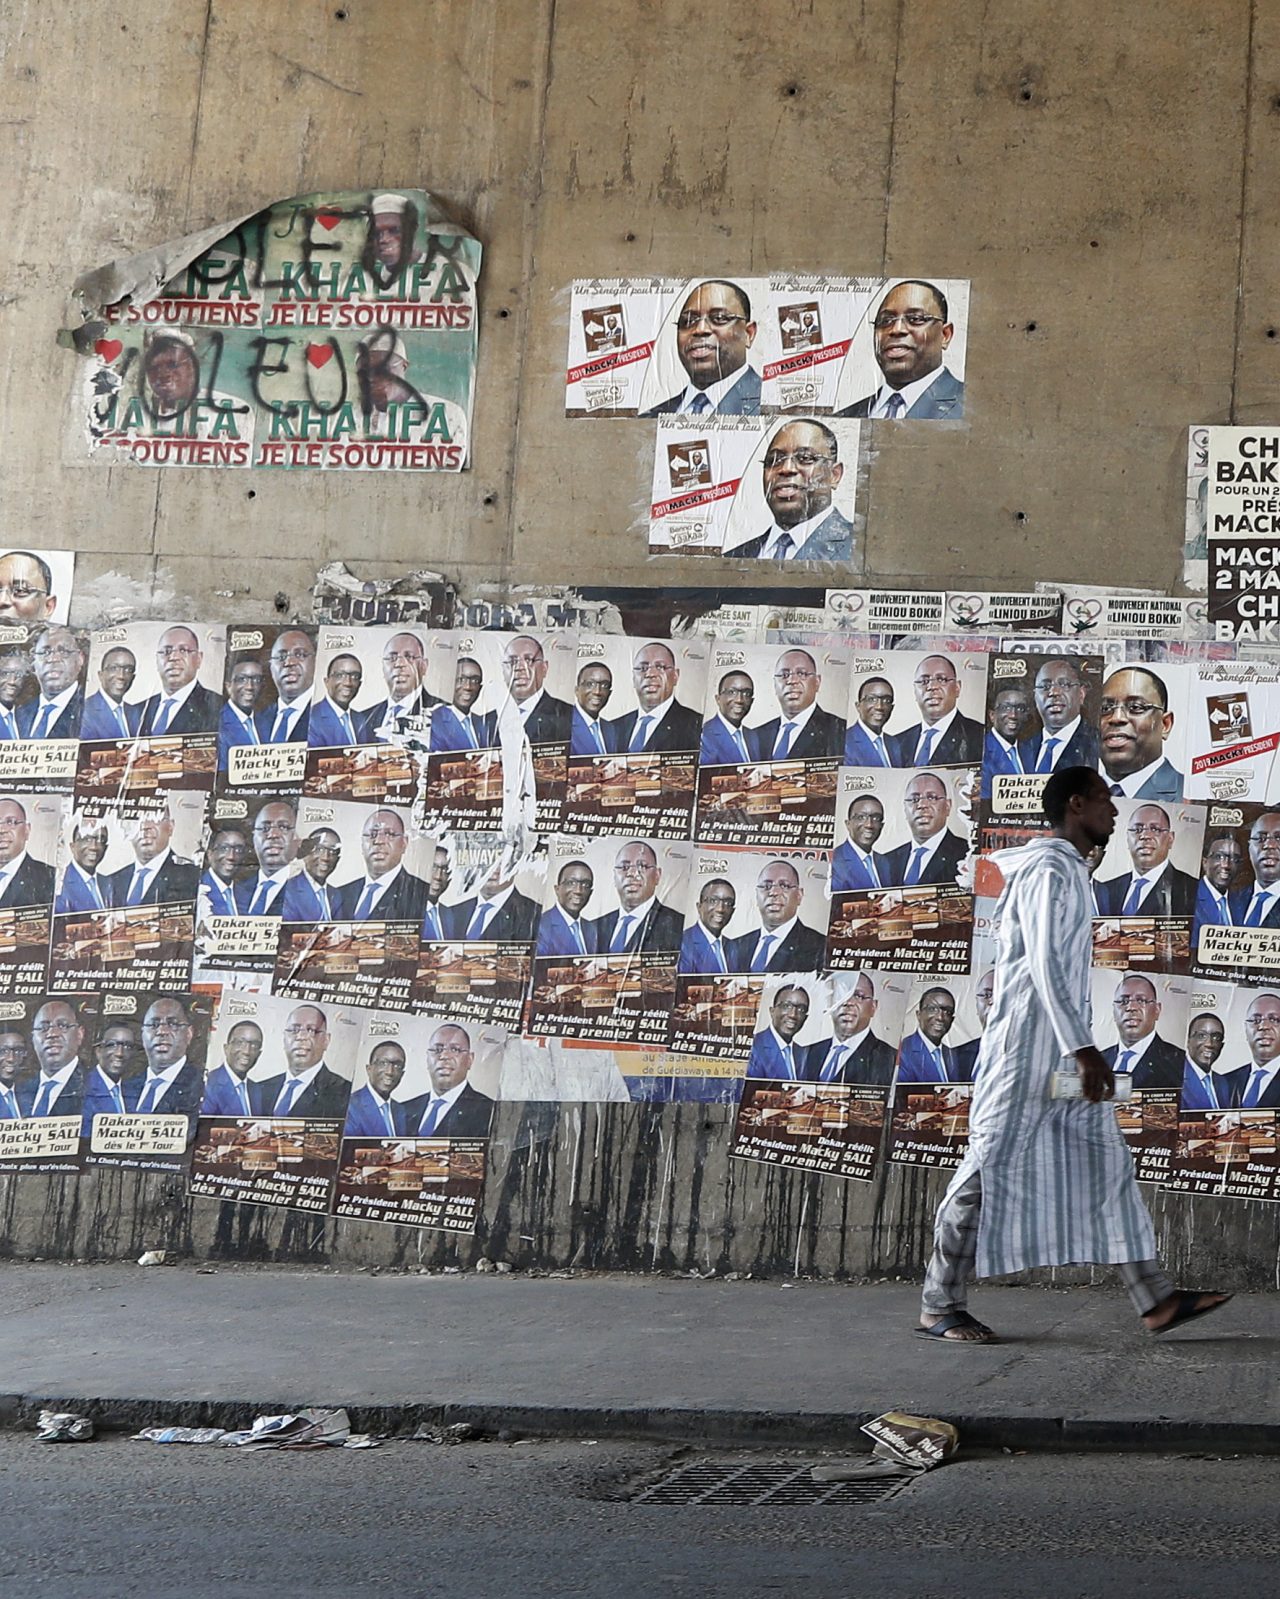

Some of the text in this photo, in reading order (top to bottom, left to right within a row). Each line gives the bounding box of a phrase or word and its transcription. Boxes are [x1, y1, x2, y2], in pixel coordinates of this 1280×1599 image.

[127, 301, 260, 325] SOUTIENS
[267, 303, 472, 328] JE LE SOUTIENS
[268, 400, 453, 443] KHALIFA
[256, 443, 462, 468] JE LE SOUTIENS
[1216, 487, 1250, 496] POUR
[1252, 487, 1270, 497] UN
[1216, 570, 1232, 589] 2
[870, 594, 943, 606] MOUVEMENT NATIONAL
[990, 596, 1030, 607] MOUVEMENT
[1108, 600, 1182, 611] MOUVEMENT NATIONAL
[868, 622, 910, 631] Lancement
[1206, 928, 1248, 939] Dakar
[1204, 939, 1252, 953] Macky
[1211, 953, 1229, 961] dès
[1233, 954, 1242, 962] le
[1205, 969, 1226, 977] Choix
[1228, 972, 1246, 980] plus
[642, 1066, 654, 1074] de
[714, 1067, 719, 1075] à
[194, 1172, 327, 1198] le Président Macky SALL
[273, 1171, 330, 1186] Dakar réélit
[191, 1182, 326, 1210] dès le premier tour
